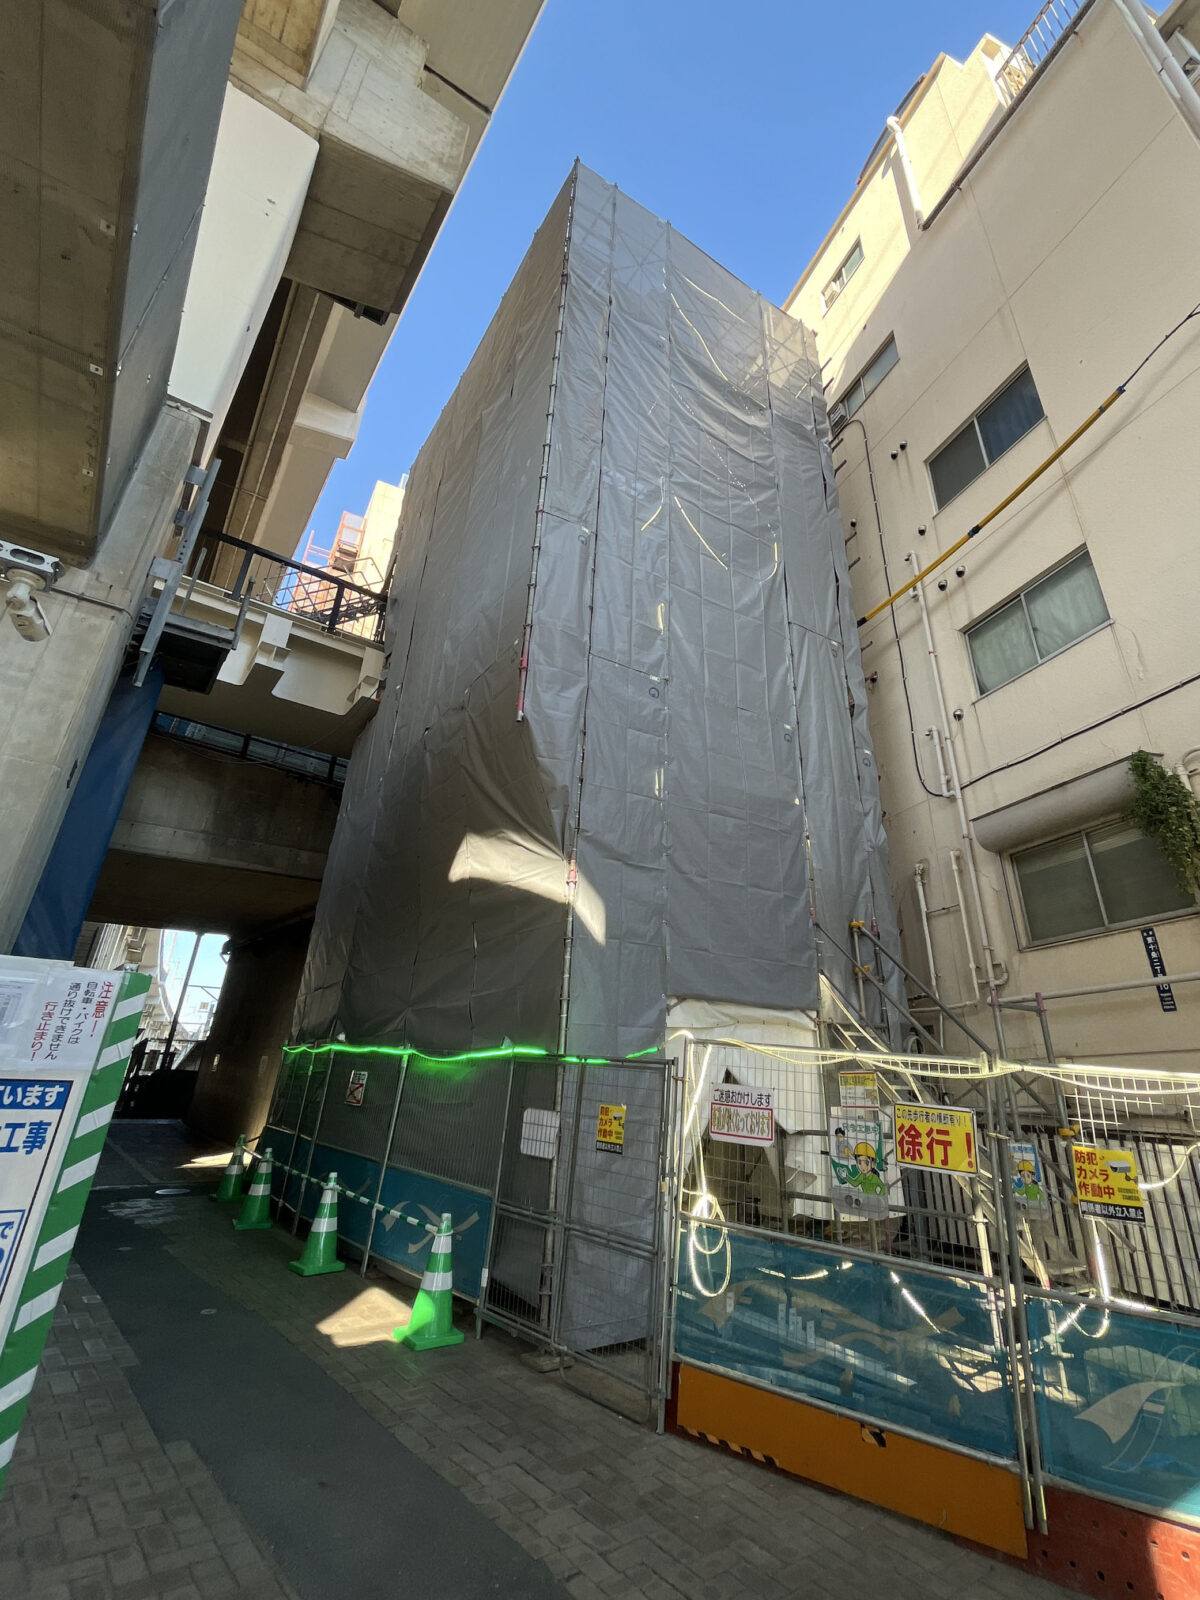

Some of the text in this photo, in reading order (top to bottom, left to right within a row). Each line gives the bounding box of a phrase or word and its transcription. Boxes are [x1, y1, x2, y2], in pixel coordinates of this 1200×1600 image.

[44, 982, 81, 1060] 通り抜けできません
[67, 982, 98, 1044] 自転車・バイクは
[90, 981, 114, 1037] 注意！
[30, 1001, 58, 1061] 行き止まり！
[713, 1088, 772, 1107] ご迷惑おかけします
[0, 1120, 53, 1155] 工事
[897, 1123, 974, 1168] 徐行！
[1074, 1150, 1098, 1165] 防犯
[1076, 1166, 1109, 1182] カメラ
[1078, 1181, 1115, 1199] 作動中
